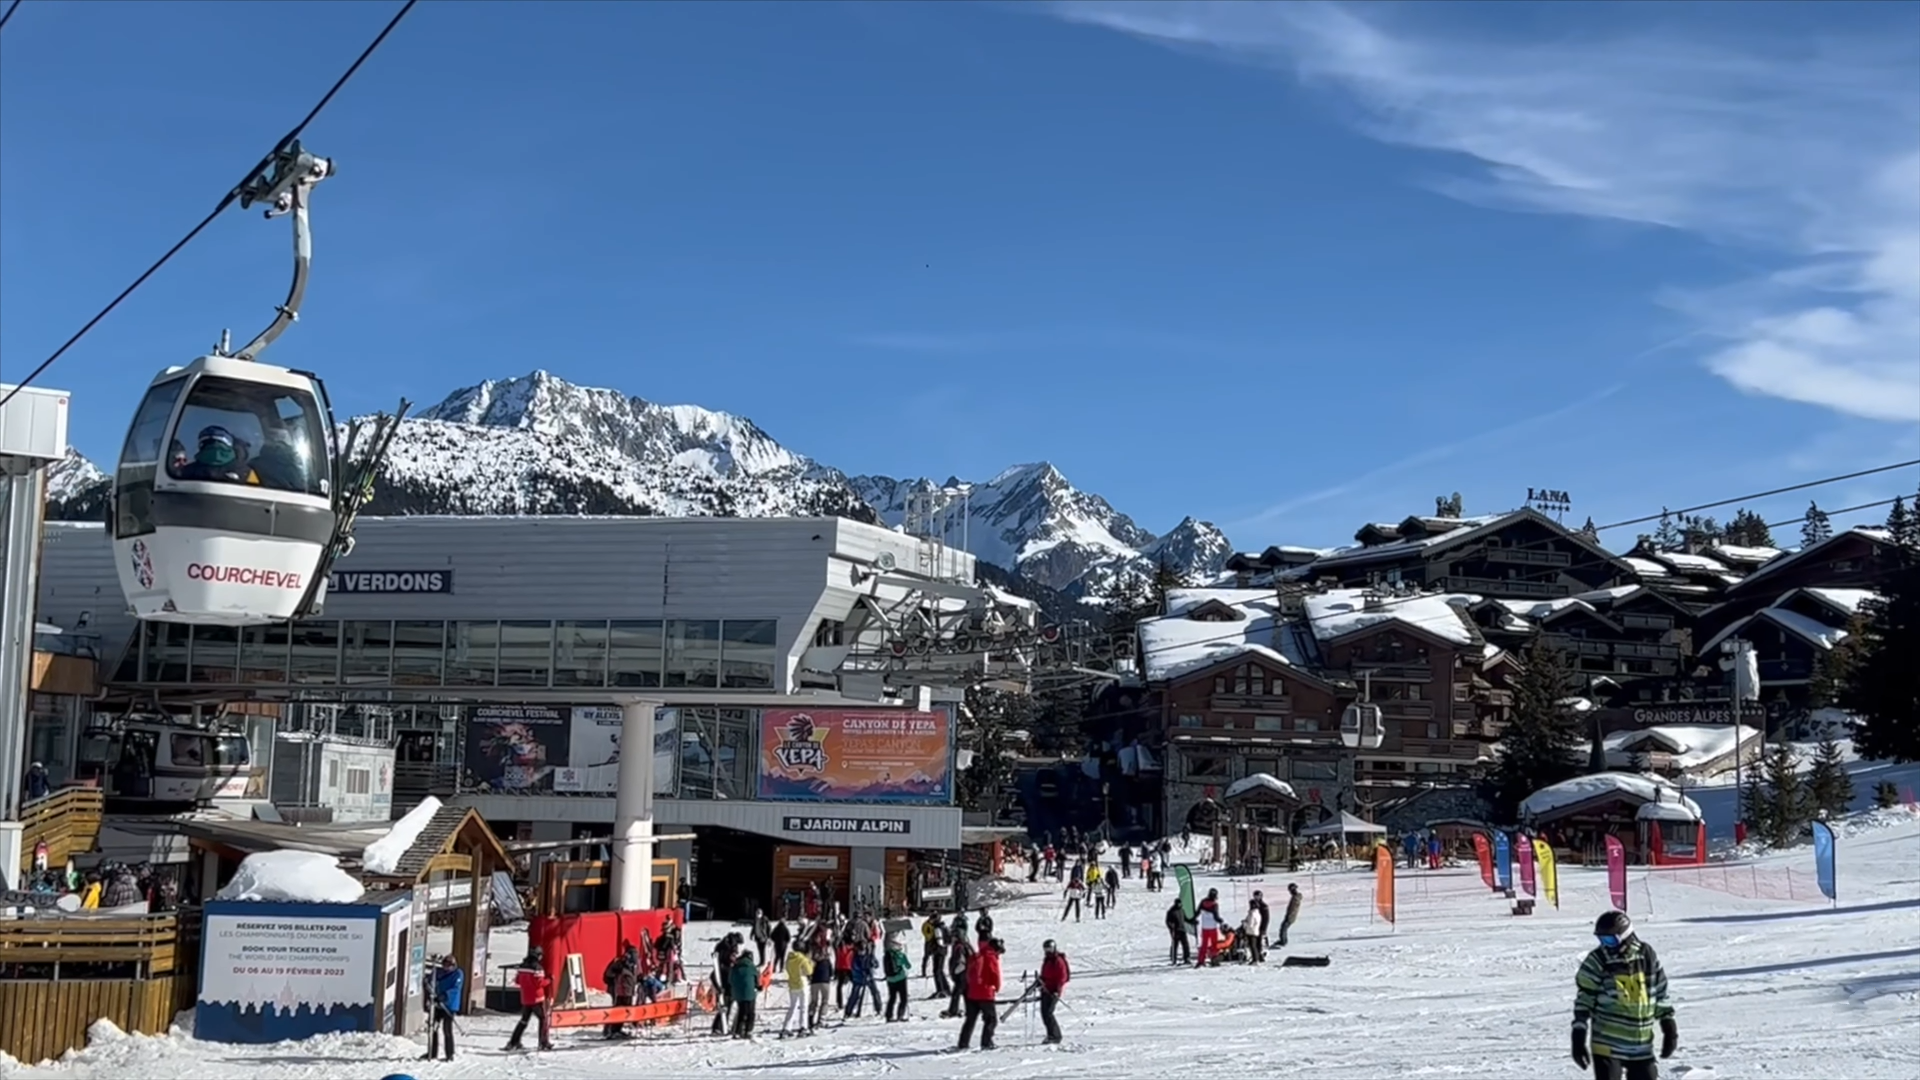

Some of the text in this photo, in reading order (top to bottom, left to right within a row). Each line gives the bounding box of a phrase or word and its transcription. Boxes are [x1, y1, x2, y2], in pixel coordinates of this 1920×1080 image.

[1527, 488, 1571, 503] LANA
[187, 563, 302, 589] COURCHEVEL
[345, 573, 443, 591] VERDONS
[477, 708, 560, 718] COURCHEVEL FESTIVAL
[596, 712, 620, 720] ALEXIS
[1634, 708, 1730, 722] GRANDES ALPES
[842, 719, 936, 730] CANYON DE YEPA
[776, 748, 827, 771] YEPA
[804, 819, 904, 832] JARDIN ALPIN
[236, 922, 275, 930] RÉSERVEZ
[235, 931, 294, 939] CHAMPIONNATS
[288, 954, 350, 962] CHAMPIONSHIPS
[286, 966, 322, 975] FÉVRIER
[324, 968, 344, 976] 2023
